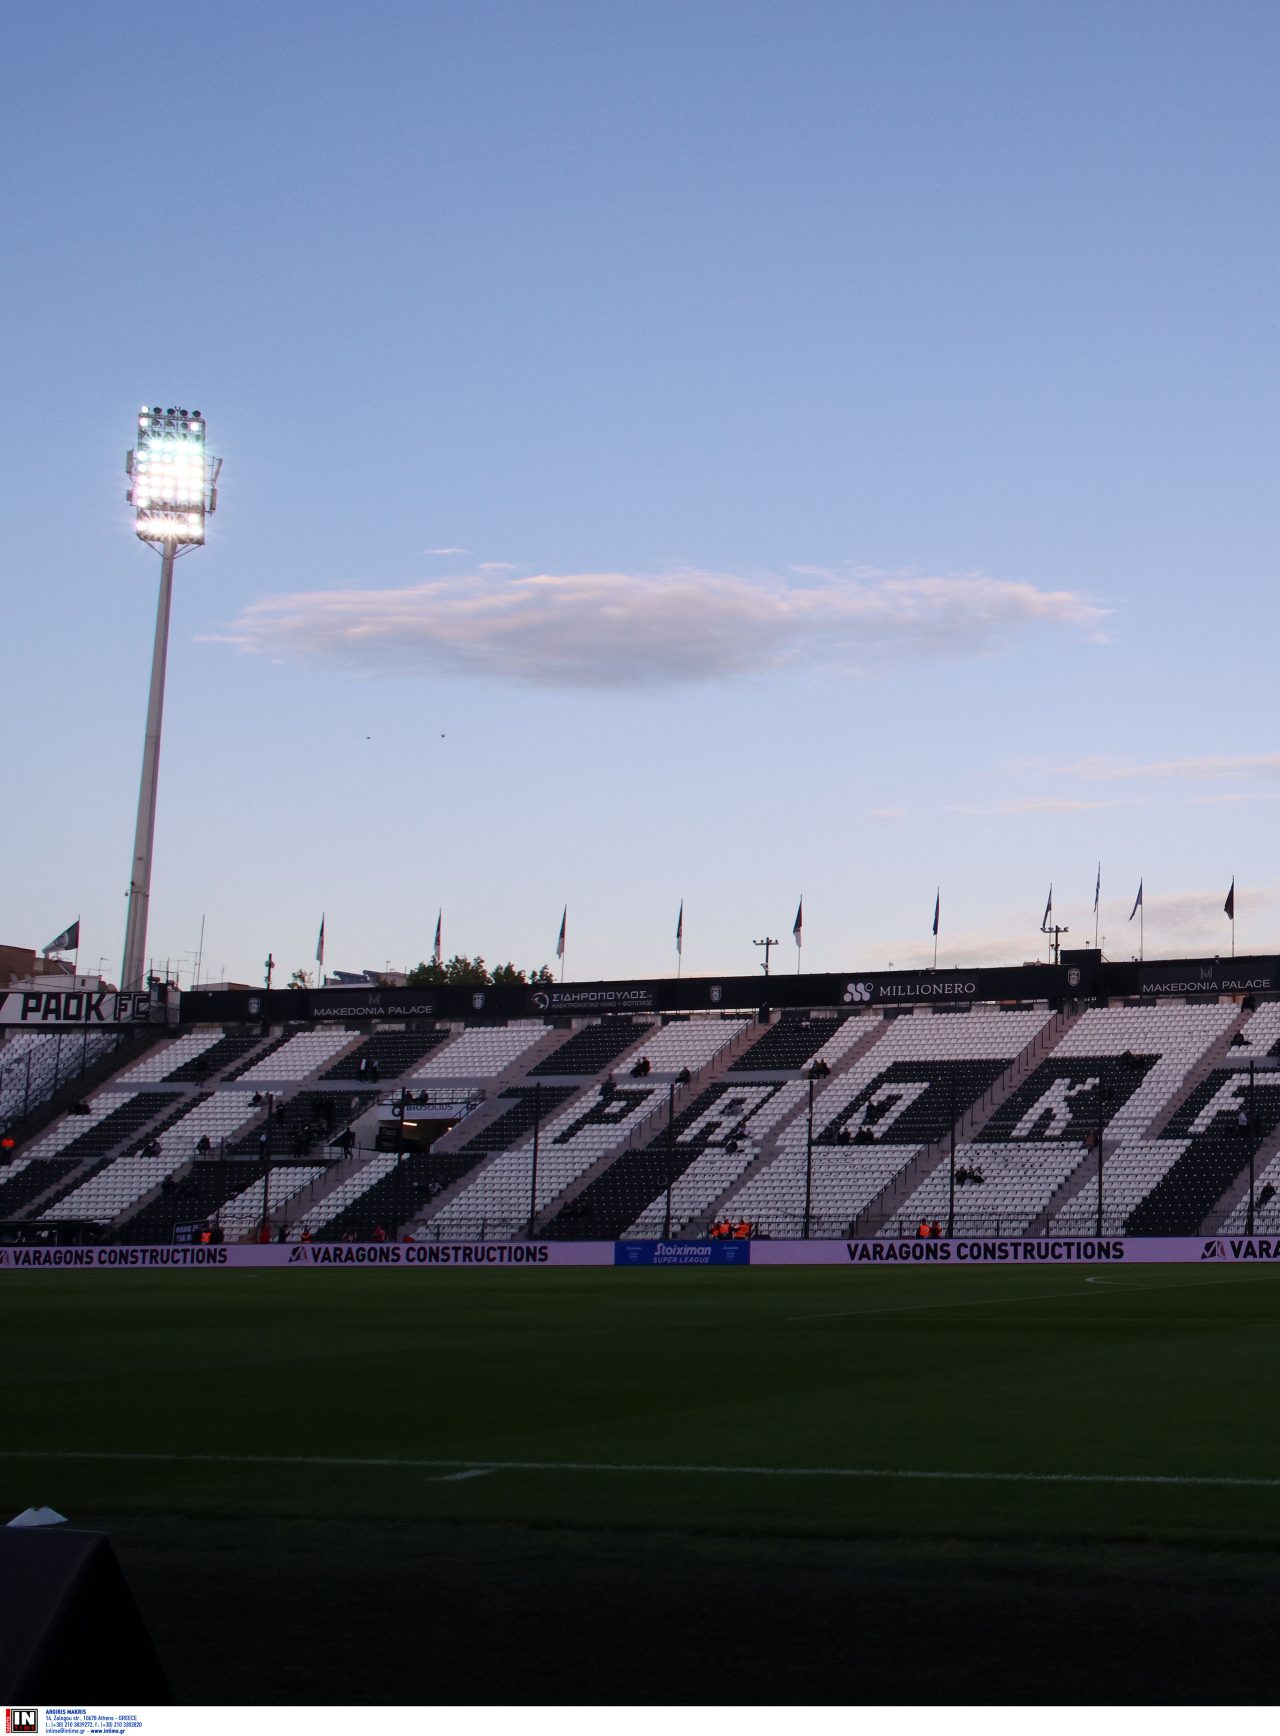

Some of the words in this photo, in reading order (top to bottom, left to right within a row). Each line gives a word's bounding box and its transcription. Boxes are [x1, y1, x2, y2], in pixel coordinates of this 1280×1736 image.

[879, 982, 976, 997] MILLIONERO
[1142, 981, 1218, 993] MAKEDONIA
[1222, 978, 1271, 990] PALACE
[552, 990, 647, 1002] ΣΙΔΗΡΟΠΟΥΛΟΣ
[21, 992, 106, 1021] PAOK
[114, 993, 150, 1021] FC
[314, 1006, 385, 1017] MAKEDONIA
[388, 1005, 433, 1015] PALACE
[13, 1249, 94, 1266] VARAGONS
[98, 1247, 228, 1265] CONSTRUCTIONS
[311, 1246, 401, 1264] VARAGONS
[405, 1245, 549, 1263] CONSTRUCTIONS
[654, 1242, 712, 1256] Stoiximan
[846, 1242, 951, 1261] VARAGONS
[956, 1241, 1124, 1260] CONSTRUCTIONS
[652, 1256, 678, 1264] SUPER
[679, 1256, 711, 1264] LEAGUE
